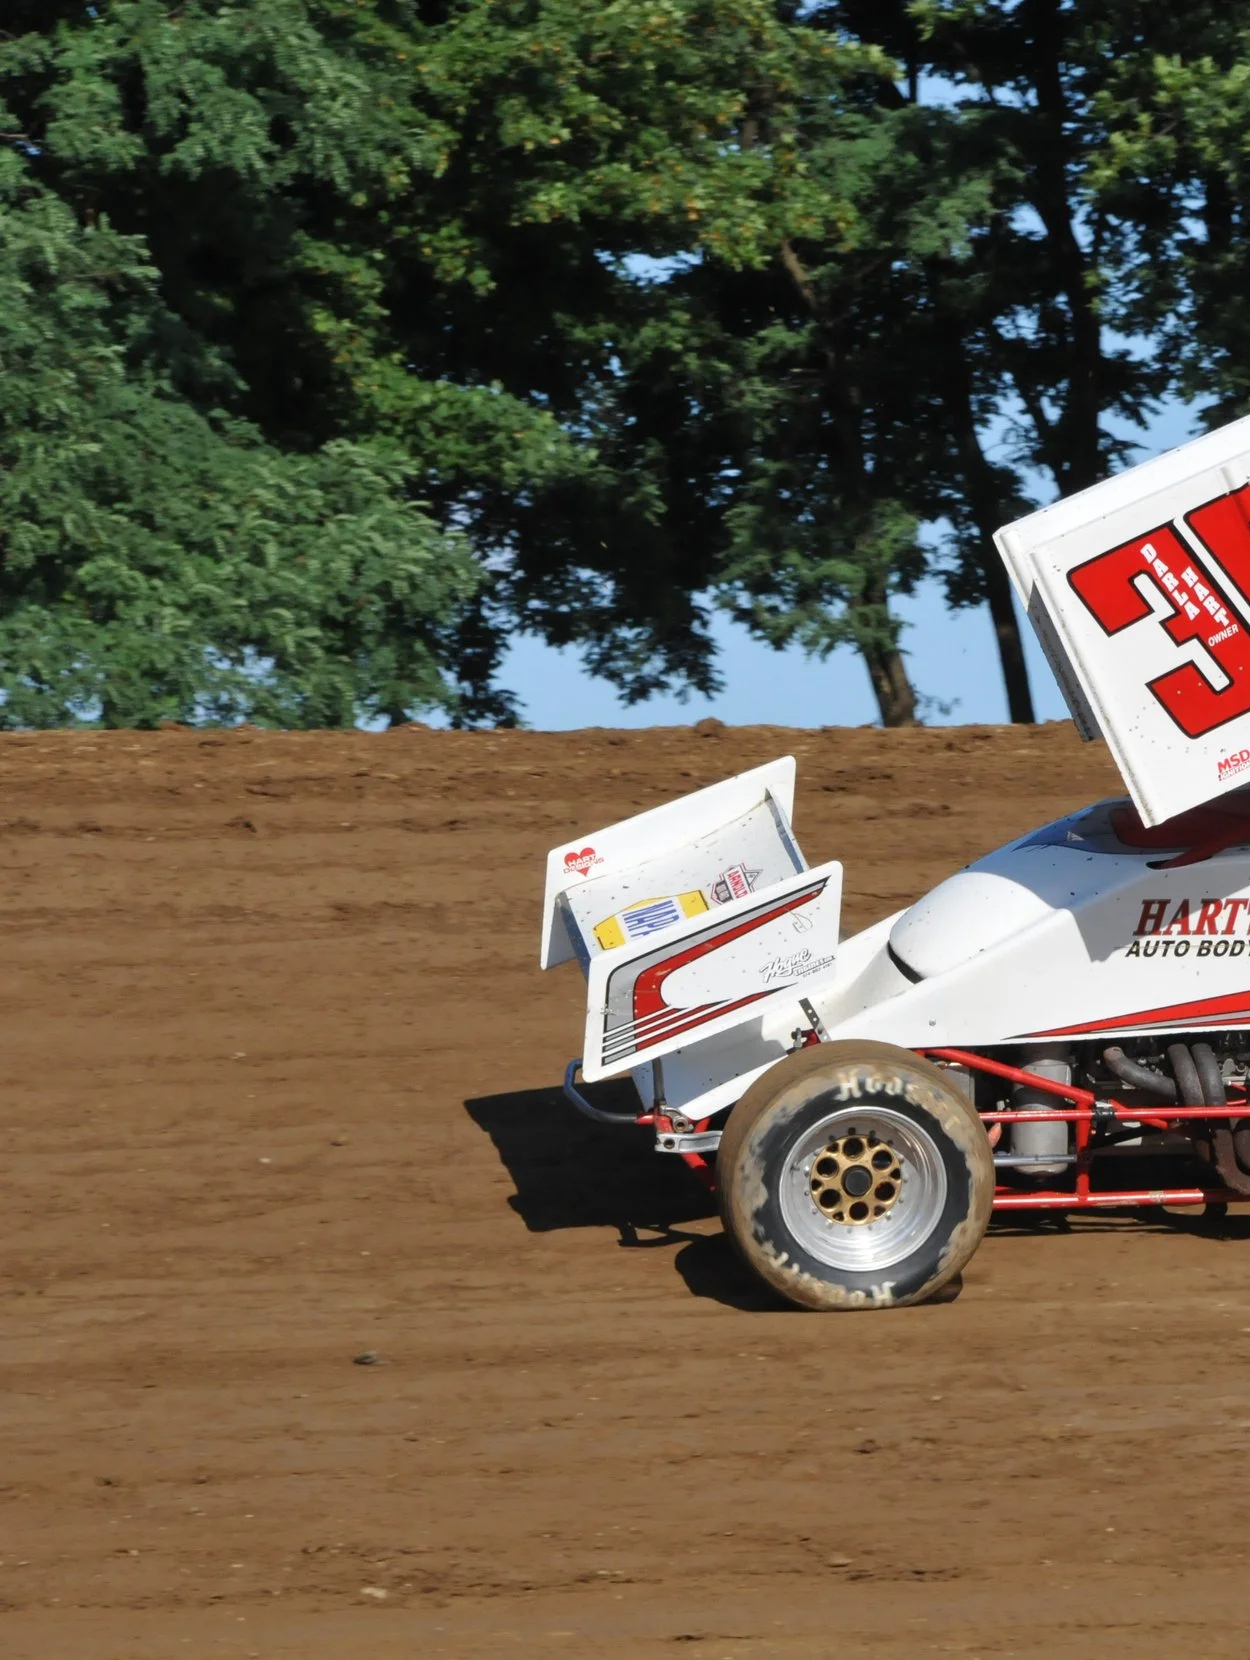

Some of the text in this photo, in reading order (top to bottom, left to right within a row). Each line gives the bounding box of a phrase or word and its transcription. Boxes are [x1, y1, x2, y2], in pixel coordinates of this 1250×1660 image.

[1140, 543, 1200, 621] DARLA
[1181, 566, 1230, 627] HART
[1208, 623, 1239, 647] OWNER
[1217, 749, 1250, 773] MSD
[727, 870, 748, 899] ARNOLD
[1125, 939, 1190, 958] AUTO
[759, 947, 812, 984] Hogue
